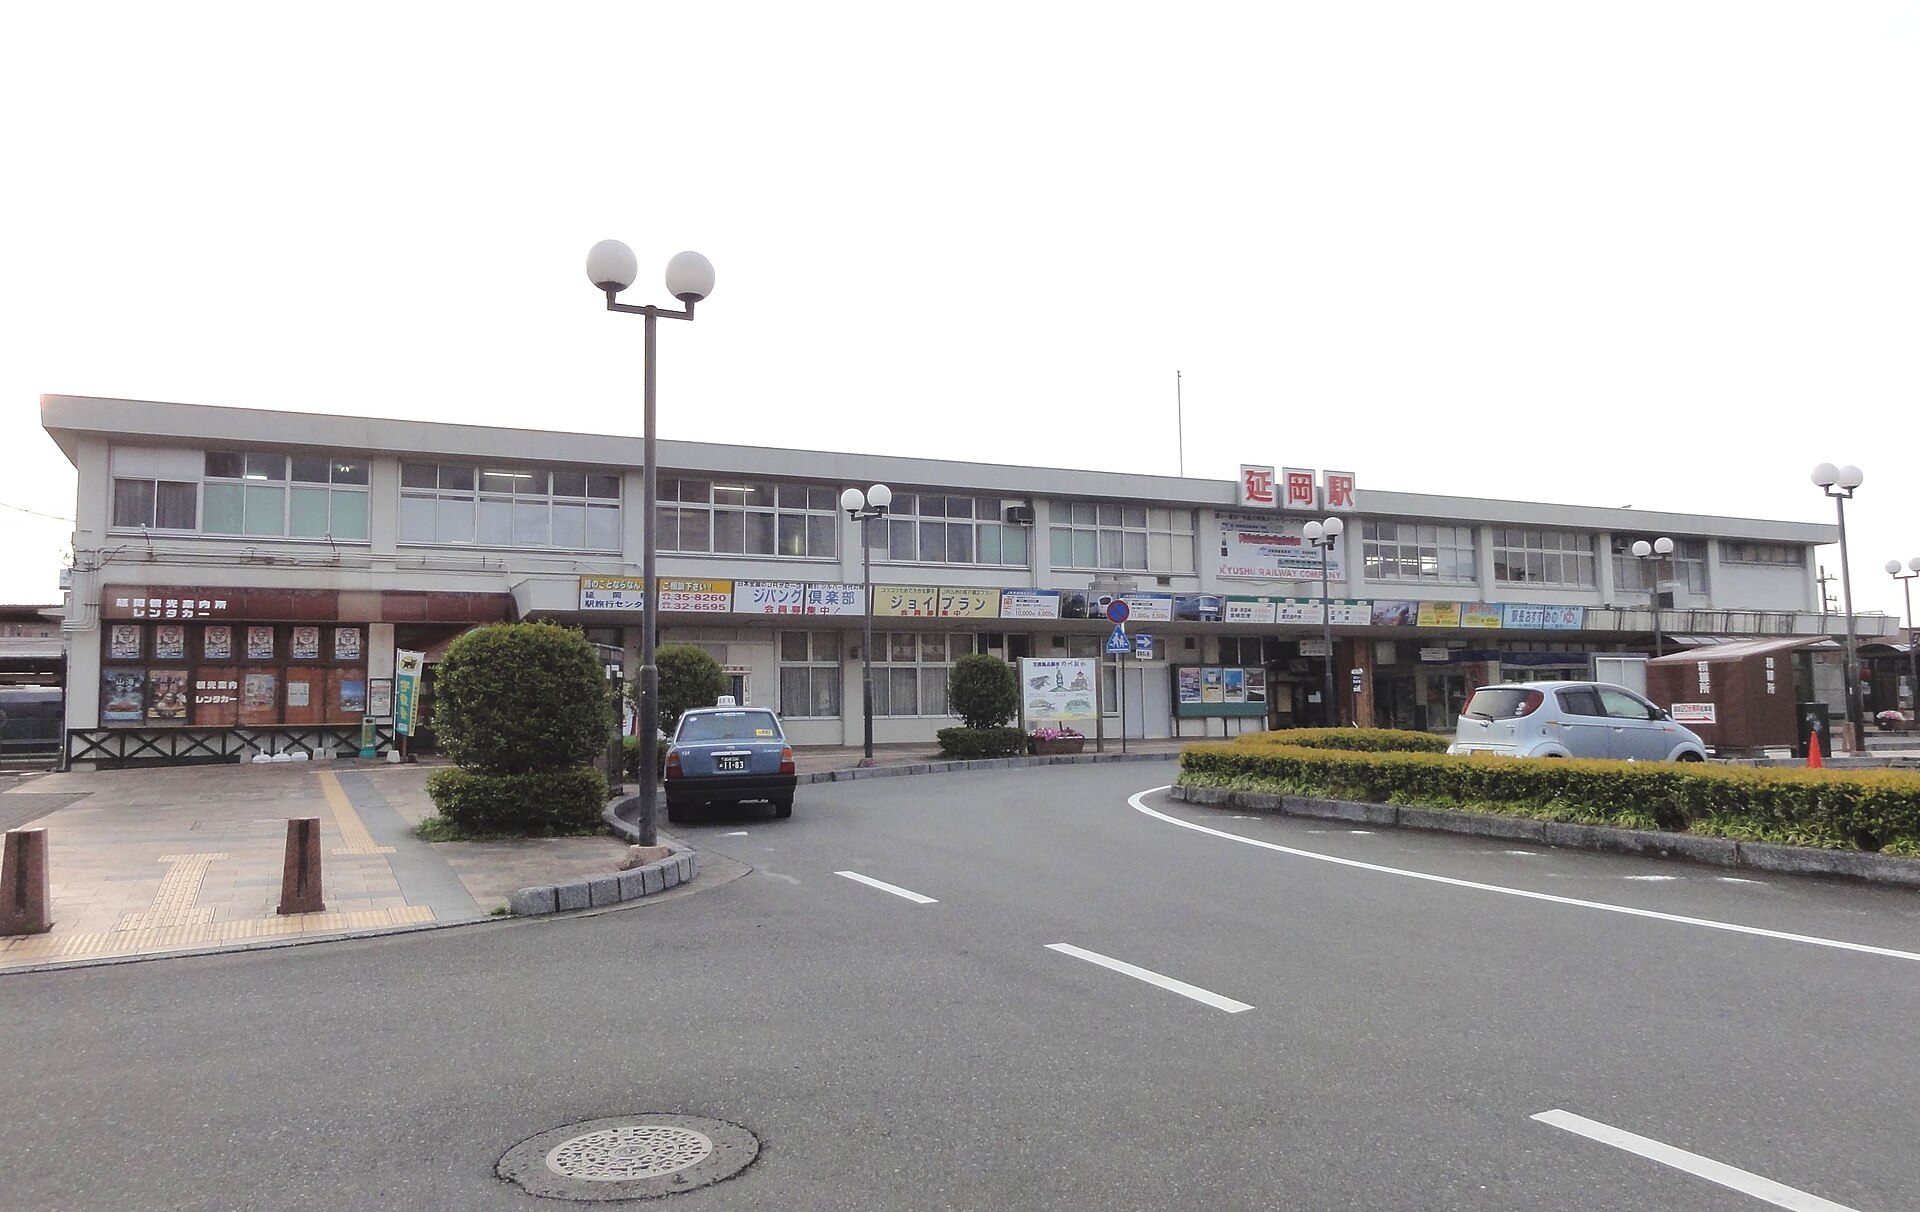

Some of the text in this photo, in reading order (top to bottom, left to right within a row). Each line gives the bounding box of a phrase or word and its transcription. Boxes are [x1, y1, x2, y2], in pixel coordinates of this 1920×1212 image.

[1245, 470, 1353, 507] 延岡駅
[1219, 564, 1341, 579] KYUSHU RAILWAY COMPNY
[673, 593, 726, 601] 35-8260
[753, 589, 855, 605] ジパング倶楽部
[116, 598, 227, 610] 延岡観光案内所
[673, 602, 726, 610] 32-6595
[890, 595, 986, 611] ジョイプラン
[133, 608, 210, 618] レンタカー
[196, 680, 238, 690] 観光案内
[195, 695, 238, 704] レンタカー
